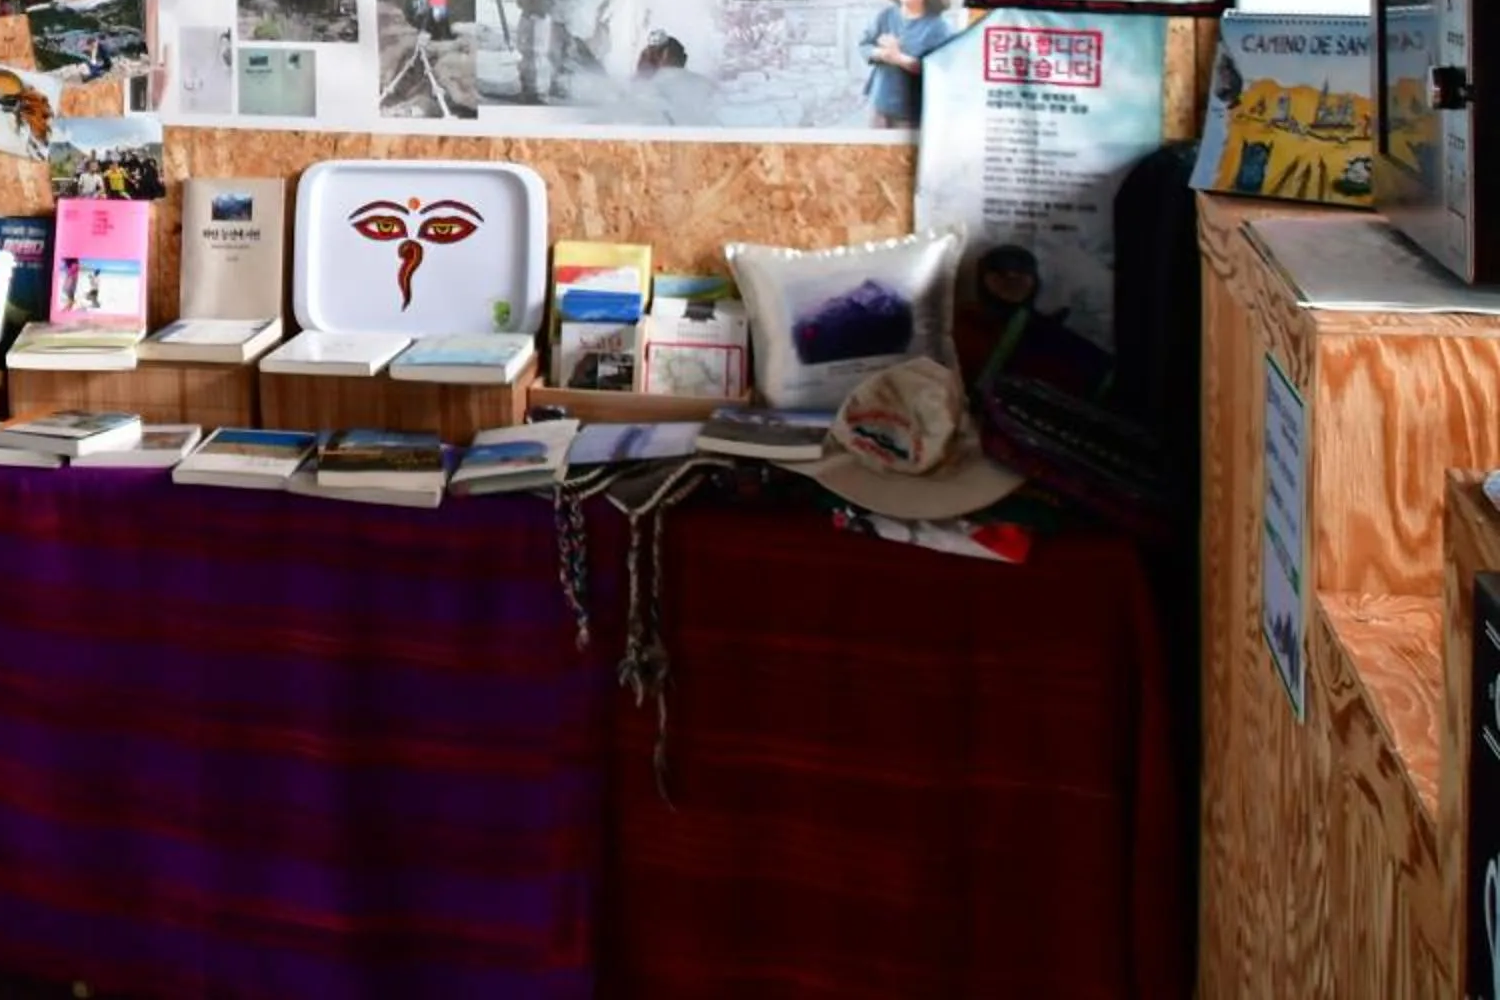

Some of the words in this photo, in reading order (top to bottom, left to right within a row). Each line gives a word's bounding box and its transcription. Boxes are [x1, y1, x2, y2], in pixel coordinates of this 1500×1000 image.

[992, 33, 1095, 56] 감사합니다
[1241, 33, 1307, 55] CAMINO
[1309, 34, 1333, 55] DE
